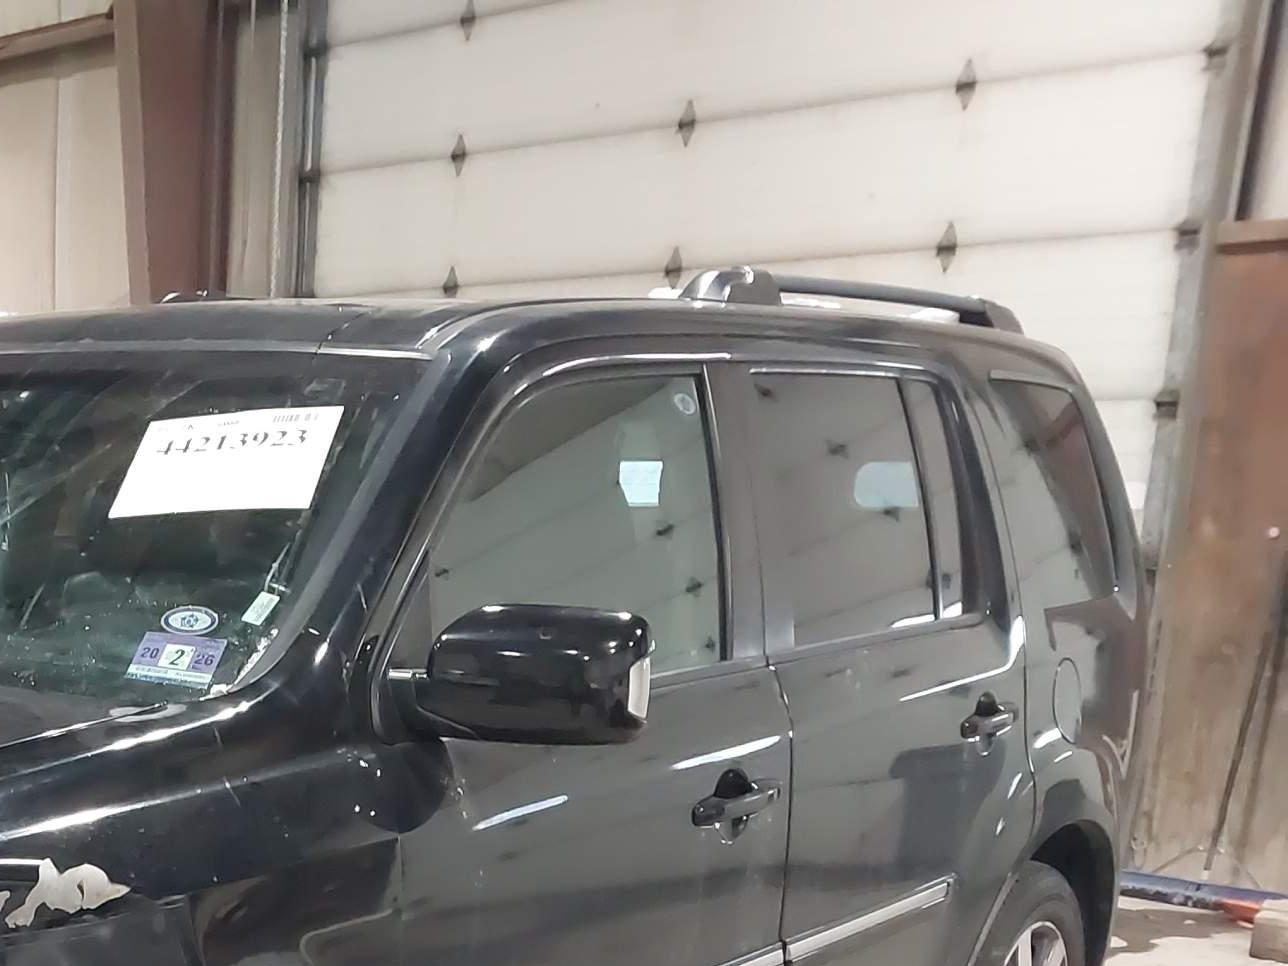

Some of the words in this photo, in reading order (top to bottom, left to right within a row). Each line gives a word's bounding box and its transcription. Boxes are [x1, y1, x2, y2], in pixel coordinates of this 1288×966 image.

[157, 430, 307, 455] 44213923
[141, 647, 159, 659] 20
[169, 649, 185, 666] 2
[194, 653, 214, 666] 26
